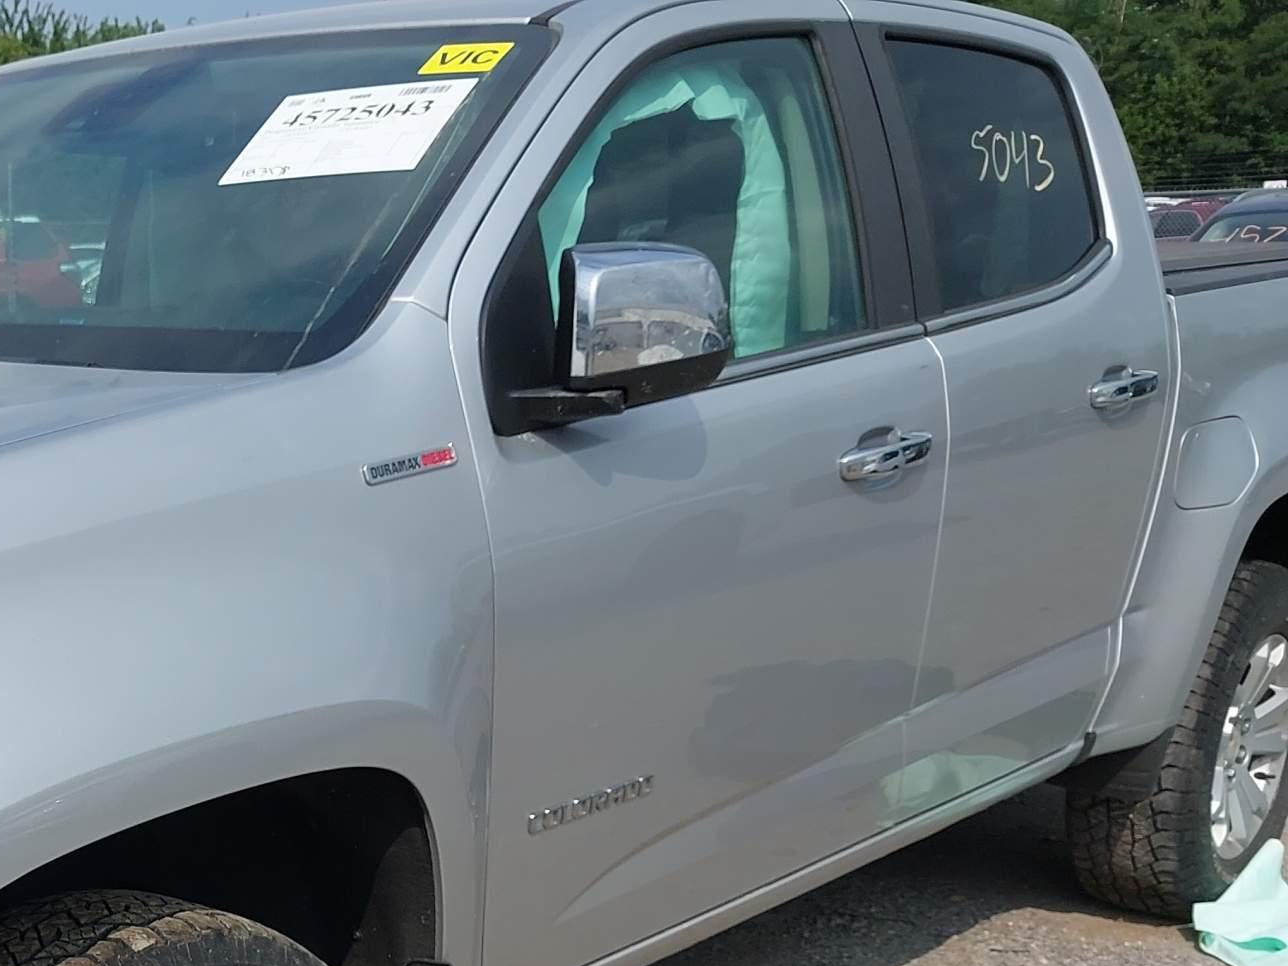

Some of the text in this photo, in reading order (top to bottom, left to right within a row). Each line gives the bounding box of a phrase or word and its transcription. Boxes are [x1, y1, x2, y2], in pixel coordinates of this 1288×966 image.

[439, 50, 499, 66] VIC
[283, 100, 435, 127] 45725043
[970, 124, 1056, 192] 5043
[370, 455, 421, 479] DURAMAX
